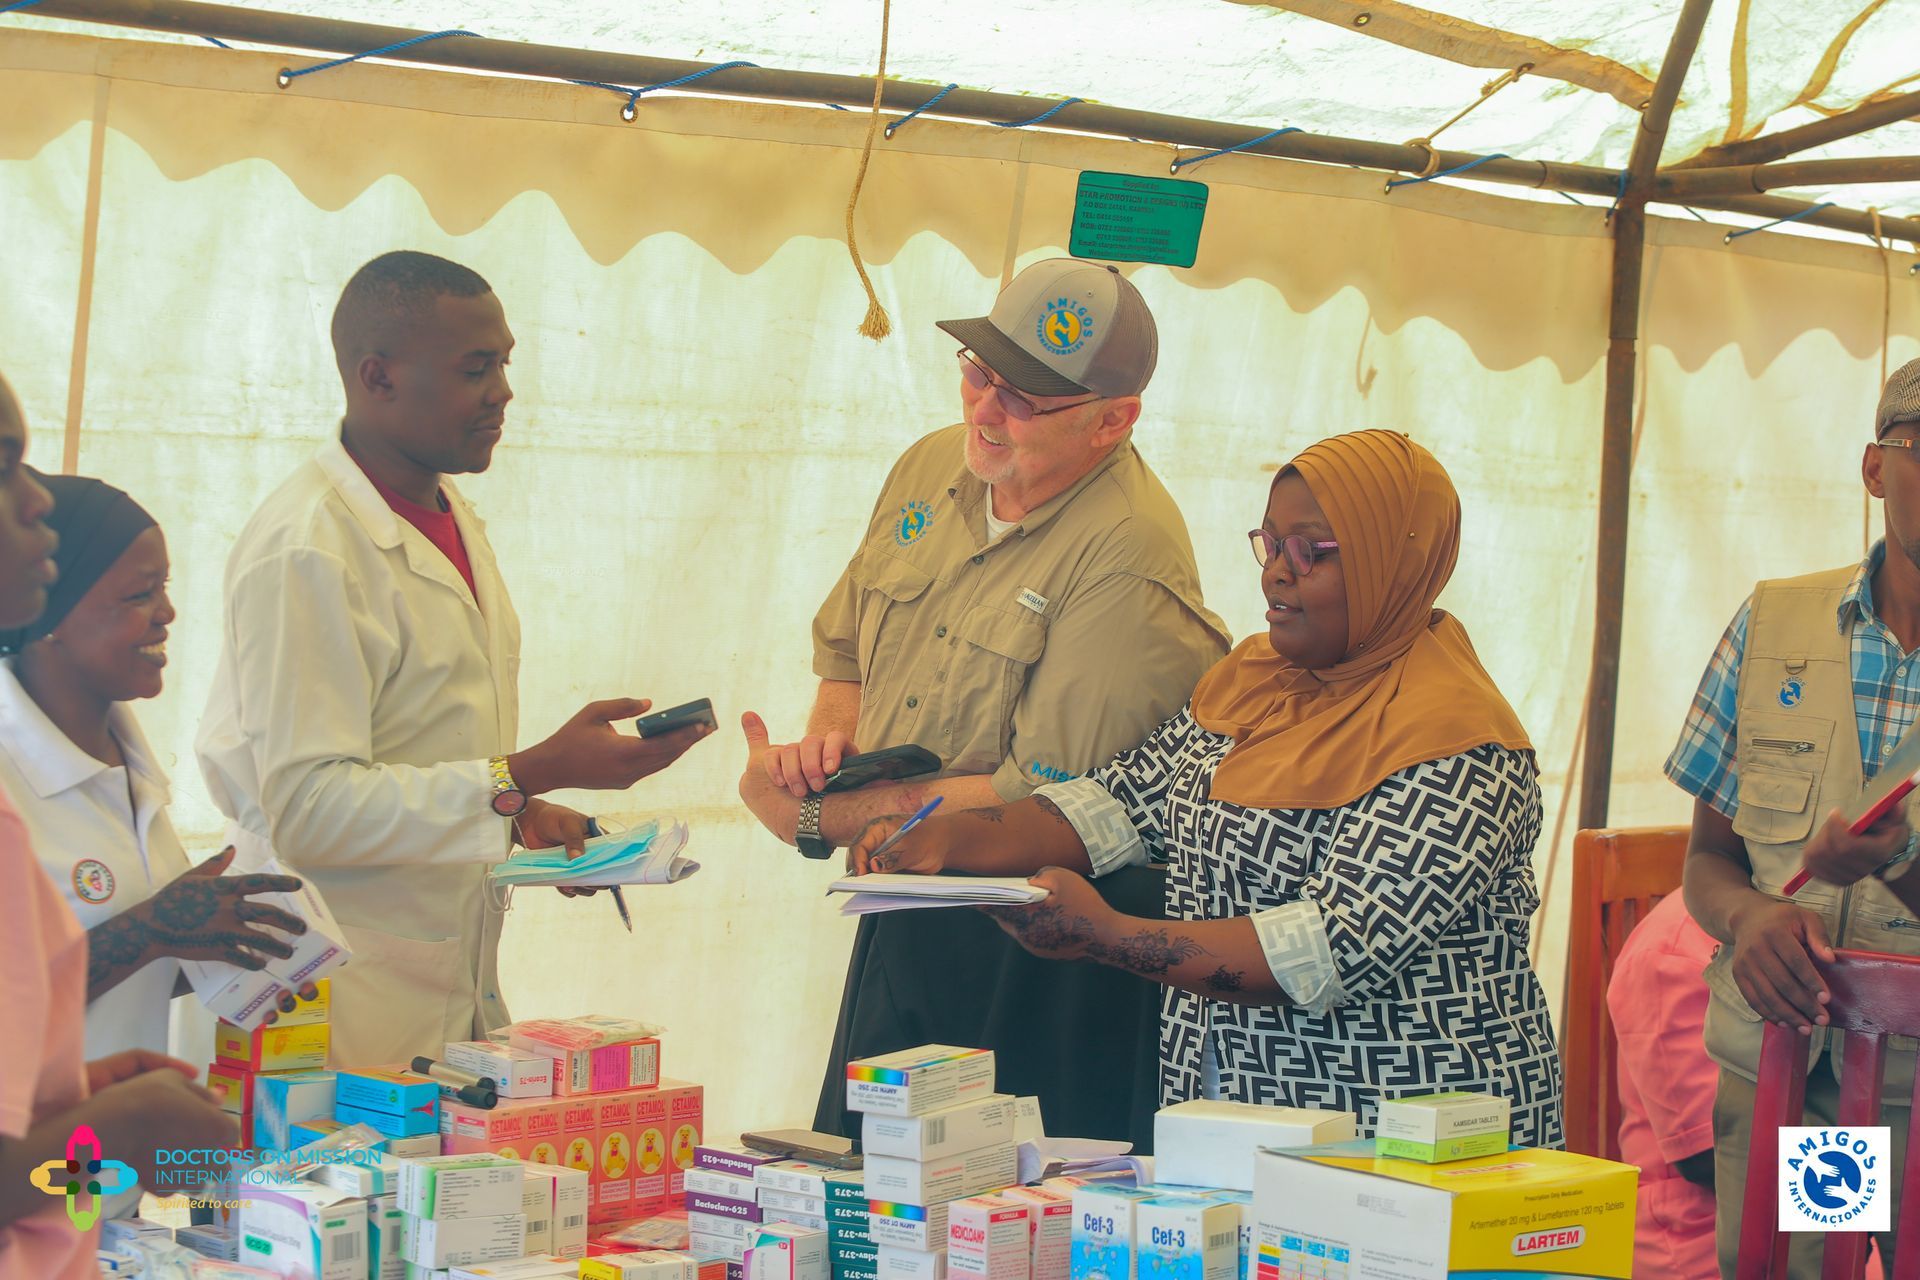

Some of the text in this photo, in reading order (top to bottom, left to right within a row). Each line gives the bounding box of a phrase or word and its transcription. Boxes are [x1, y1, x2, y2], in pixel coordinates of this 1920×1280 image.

[1100, 192, 1143, 204] PROMOTION
[1047, 297, 1093, 338] AMIGOS
[900, 501, 934, 527] AMIGOS
[1478, 1115, 1499, 1124] TABLETS
[694, 1199, 748, 1215] Bactoclav-625
[1469, 1201, 1625, 1230] Artemether 20 mg & Lumefantrine 120 mg Tablets
[1084, 1213, 1113, 1236] Cef-3
[1152, 1226, 1185, 1248] Cef-3
[1517, 1230, 1580, 1252] LARTEM
